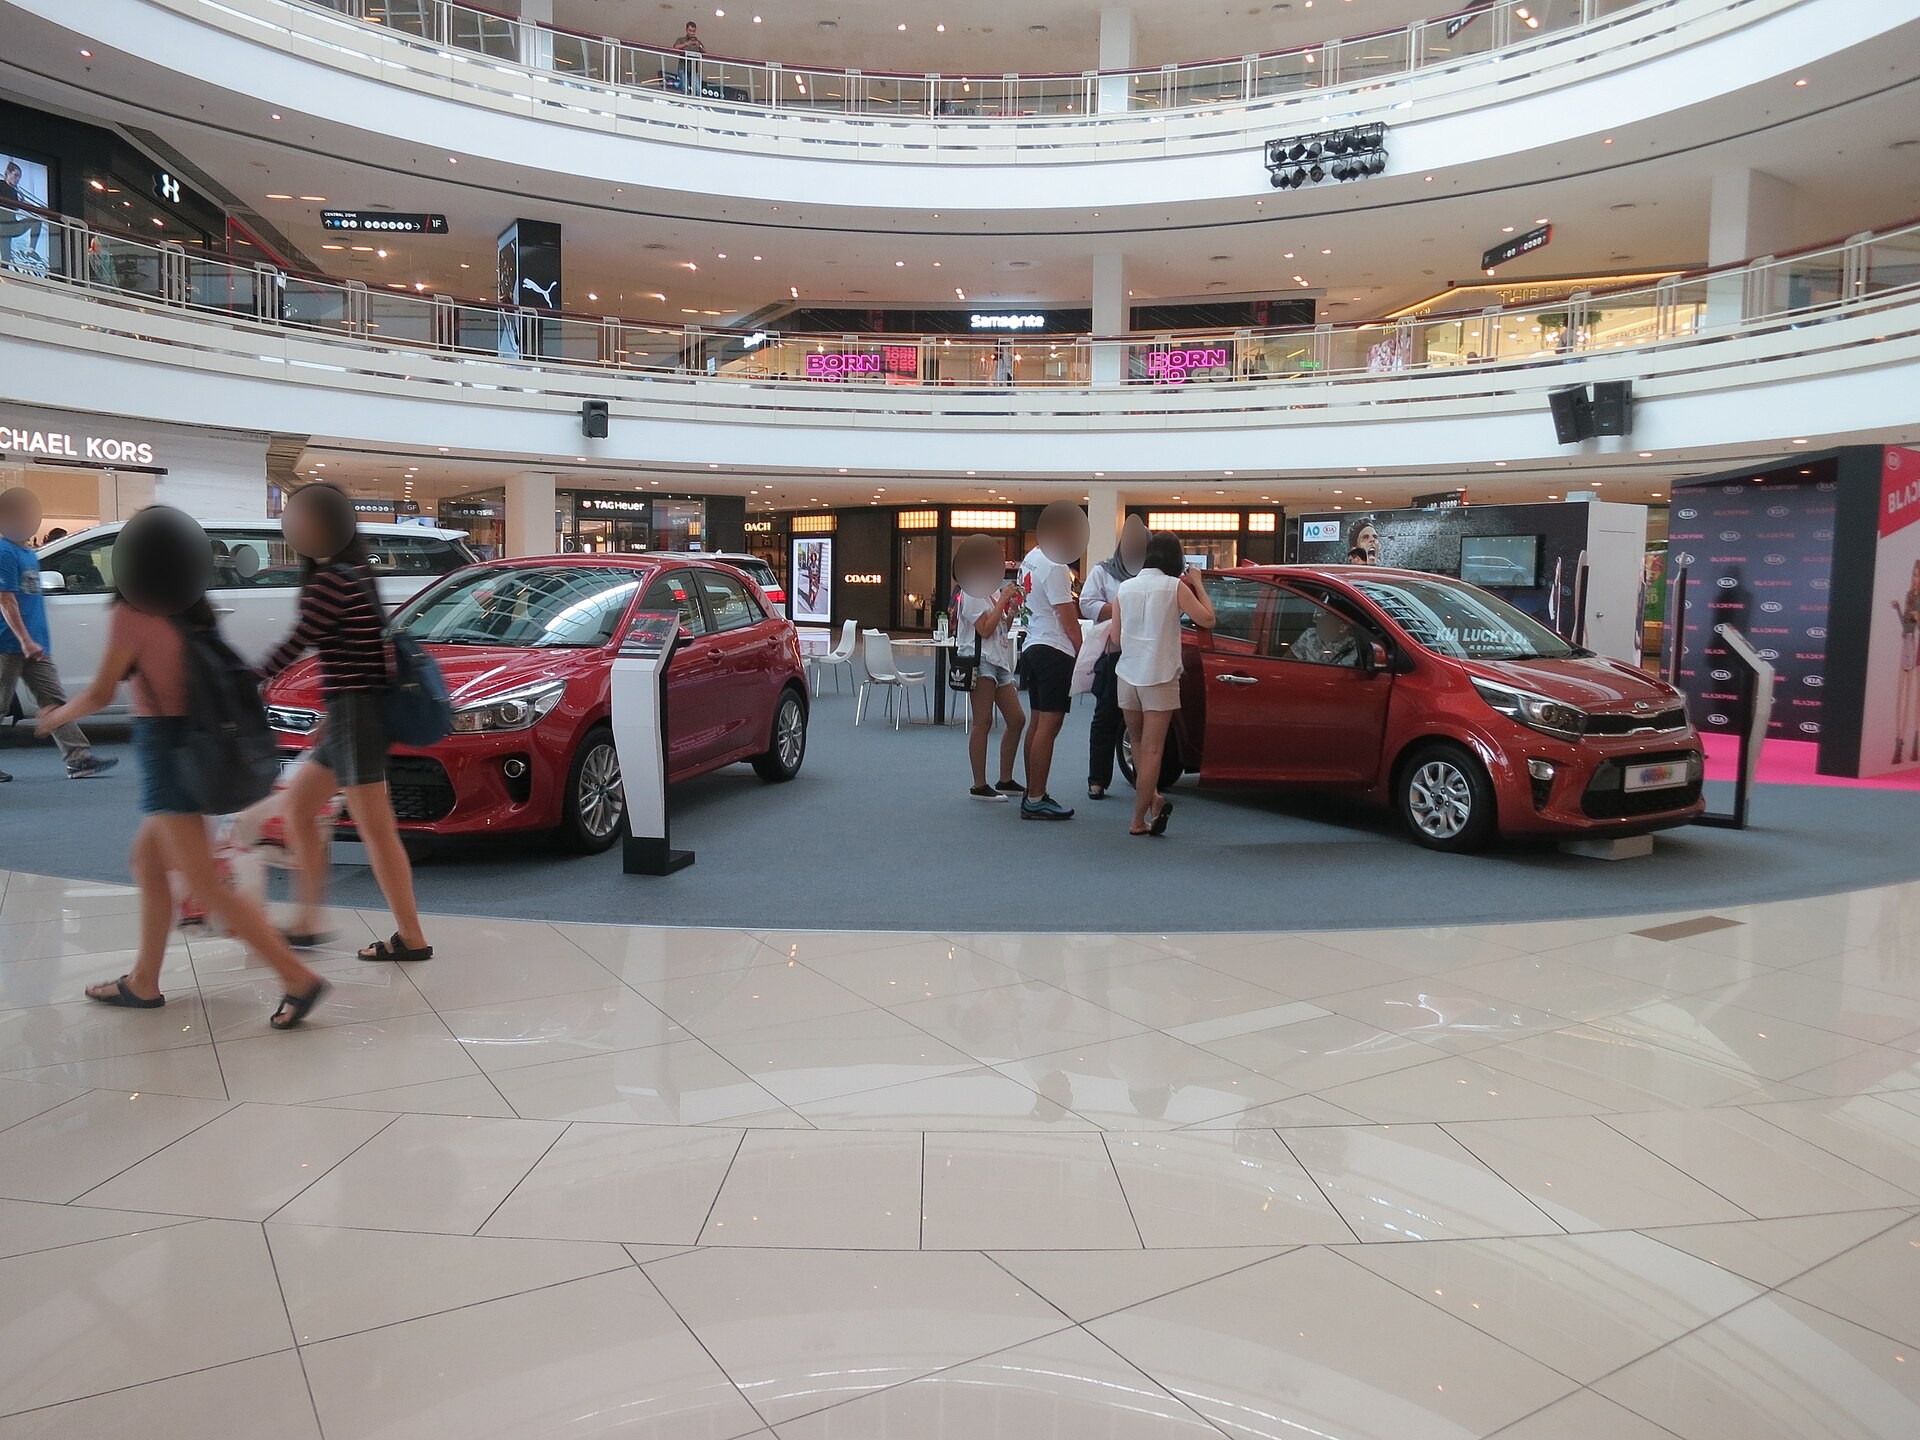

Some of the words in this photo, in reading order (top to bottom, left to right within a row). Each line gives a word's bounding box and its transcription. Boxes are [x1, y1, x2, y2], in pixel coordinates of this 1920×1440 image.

[431, 219, 442, 228] 1F
[970, 314, 1045, 329] Samsonite
[806, 354, 880, 371] BORN
[1149, 349, 1226, 370] BORN
[0, 426, 77, 456] CHAEL
[86, 436, 153, 463] KORS
[1888, 479, 1920, 514] BLAC
[744, 522, 771, 532] OACH
[1305, 525, 1320, 536] AO
[844, 574, 882, 584] COACH
[1462, 627, 1509, 643] LUCKY
